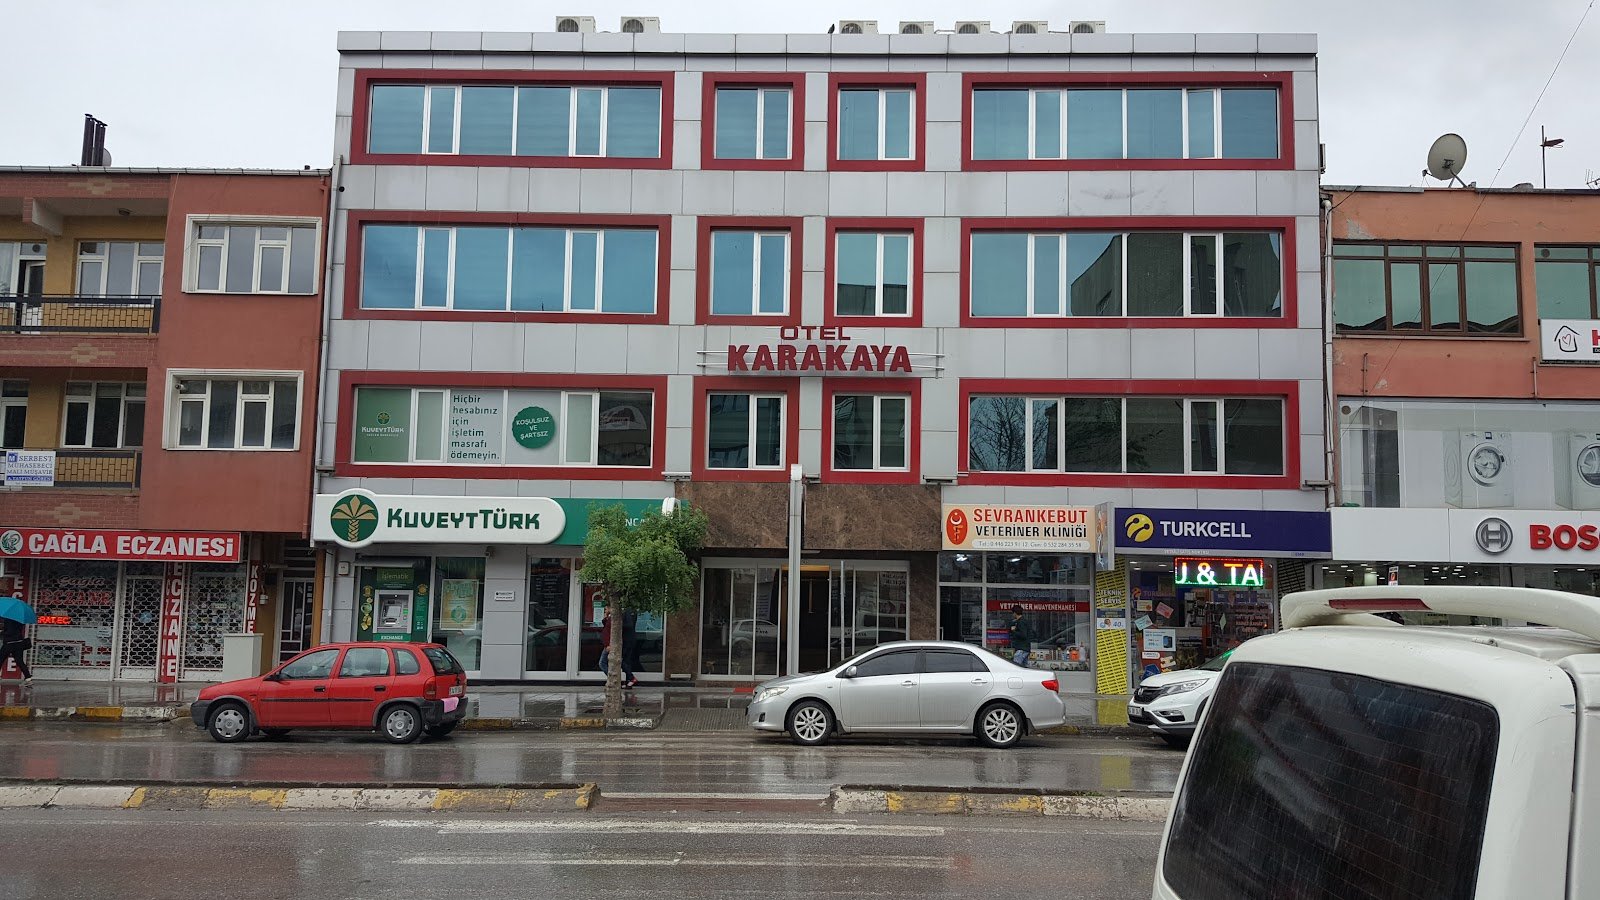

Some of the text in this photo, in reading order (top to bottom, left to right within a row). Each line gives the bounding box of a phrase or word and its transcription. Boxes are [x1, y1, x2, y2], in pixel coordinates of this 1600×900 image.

[780, 326, 851, 340] OTEL
[727, 345, 912, 372] KARAKAYA
[453, 395, 481, 404] Hiçbir
[453, 406, 498, 415] hesabınız
[452, 417, 469, 426] için
[516, 416, 550, 425] KOŞULSUZ
[451, 428, 484, 438] işletim
[451, 439, 487, 448] masrafı
[450, 451, 500, 461] ödemeyin.
[973, 508, 1088, 524] SEVRANKEBUT
[975, 523, 1087, 538] VETERİNER KLİNİĞİ
[1160, 521, 1252, 538] TURKCELL
[28, 531, 234, 557] ÇAĞLA ECZANESİ
[1529, 525, 1600, 550] BOS
[1196, 562, 1218, 585] &
[167, 562, 182, 676] ECZANE
